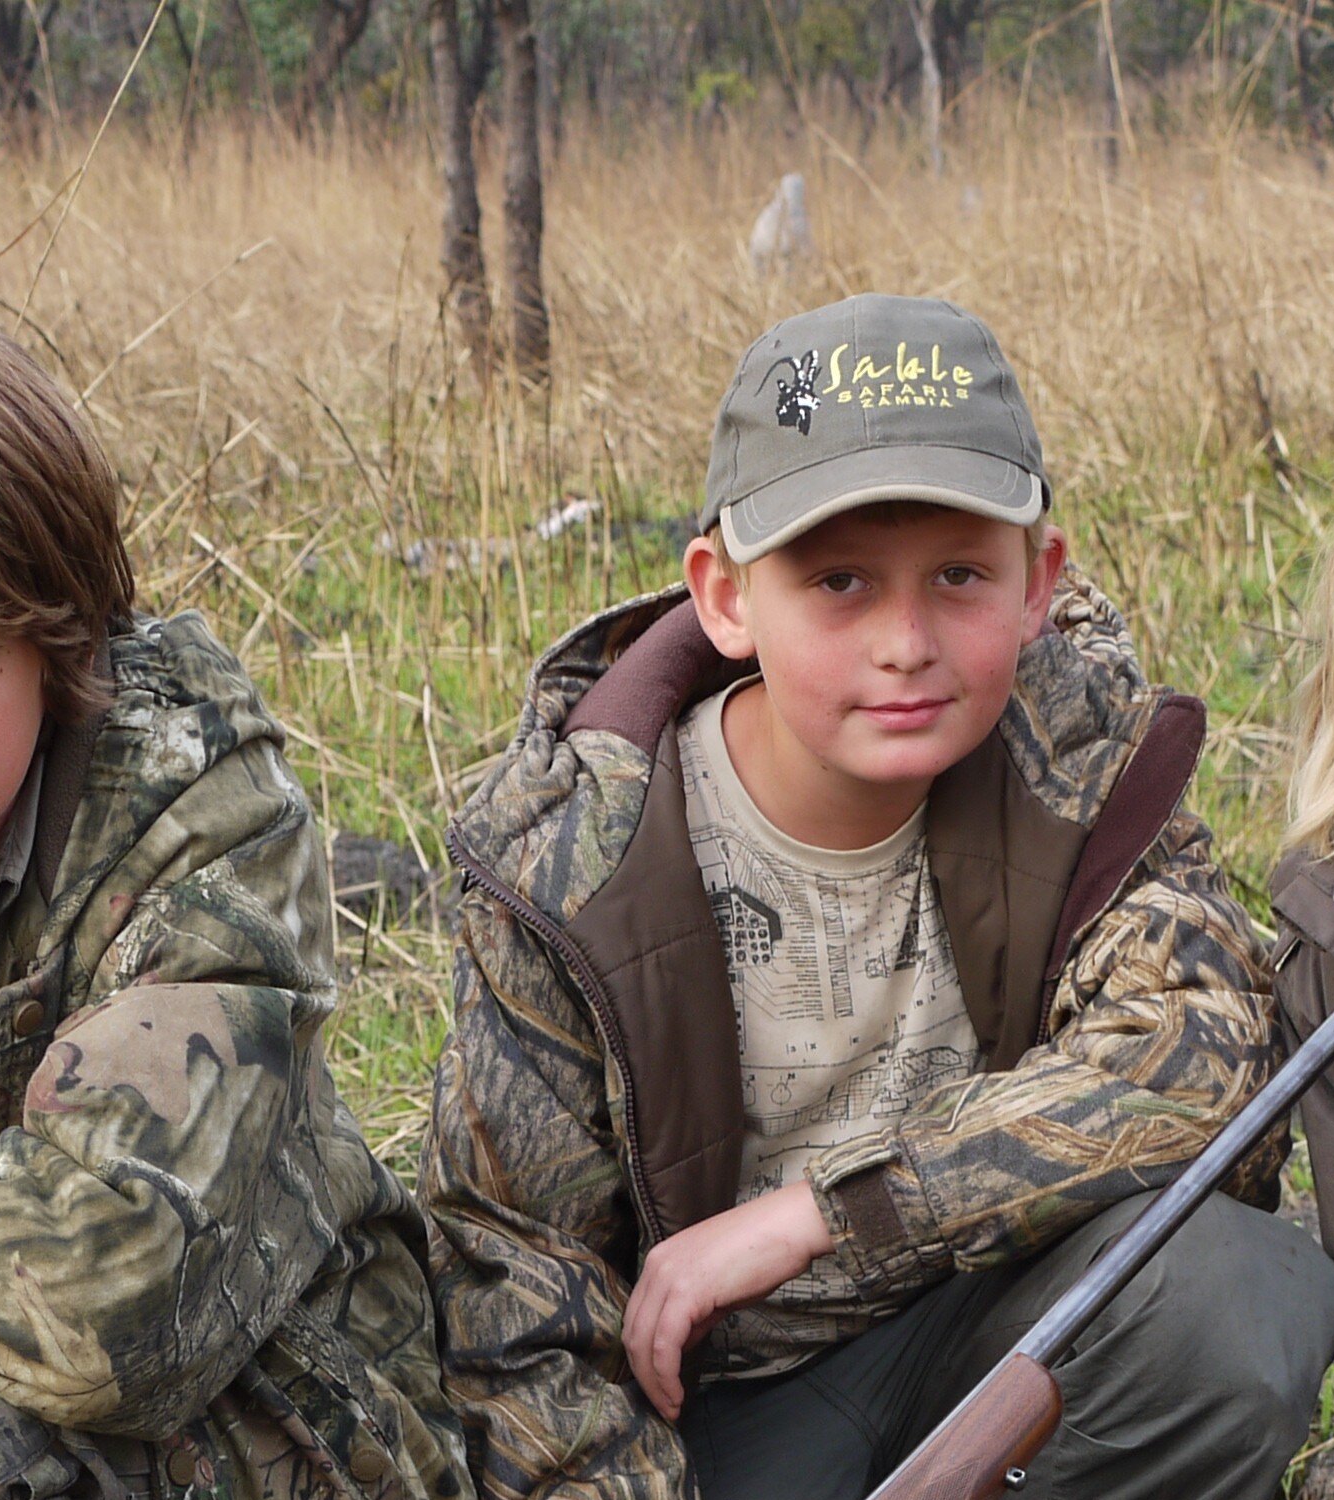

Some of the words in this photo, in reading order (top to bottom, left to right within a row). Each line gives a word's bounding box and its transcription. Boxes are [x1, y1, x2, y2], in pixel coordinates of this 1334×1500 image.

[822, 341, 974, 395] Sable
[837, 383, 969, 403] SAFARIS
[860, 395, 954, 408] ZAMBIA
